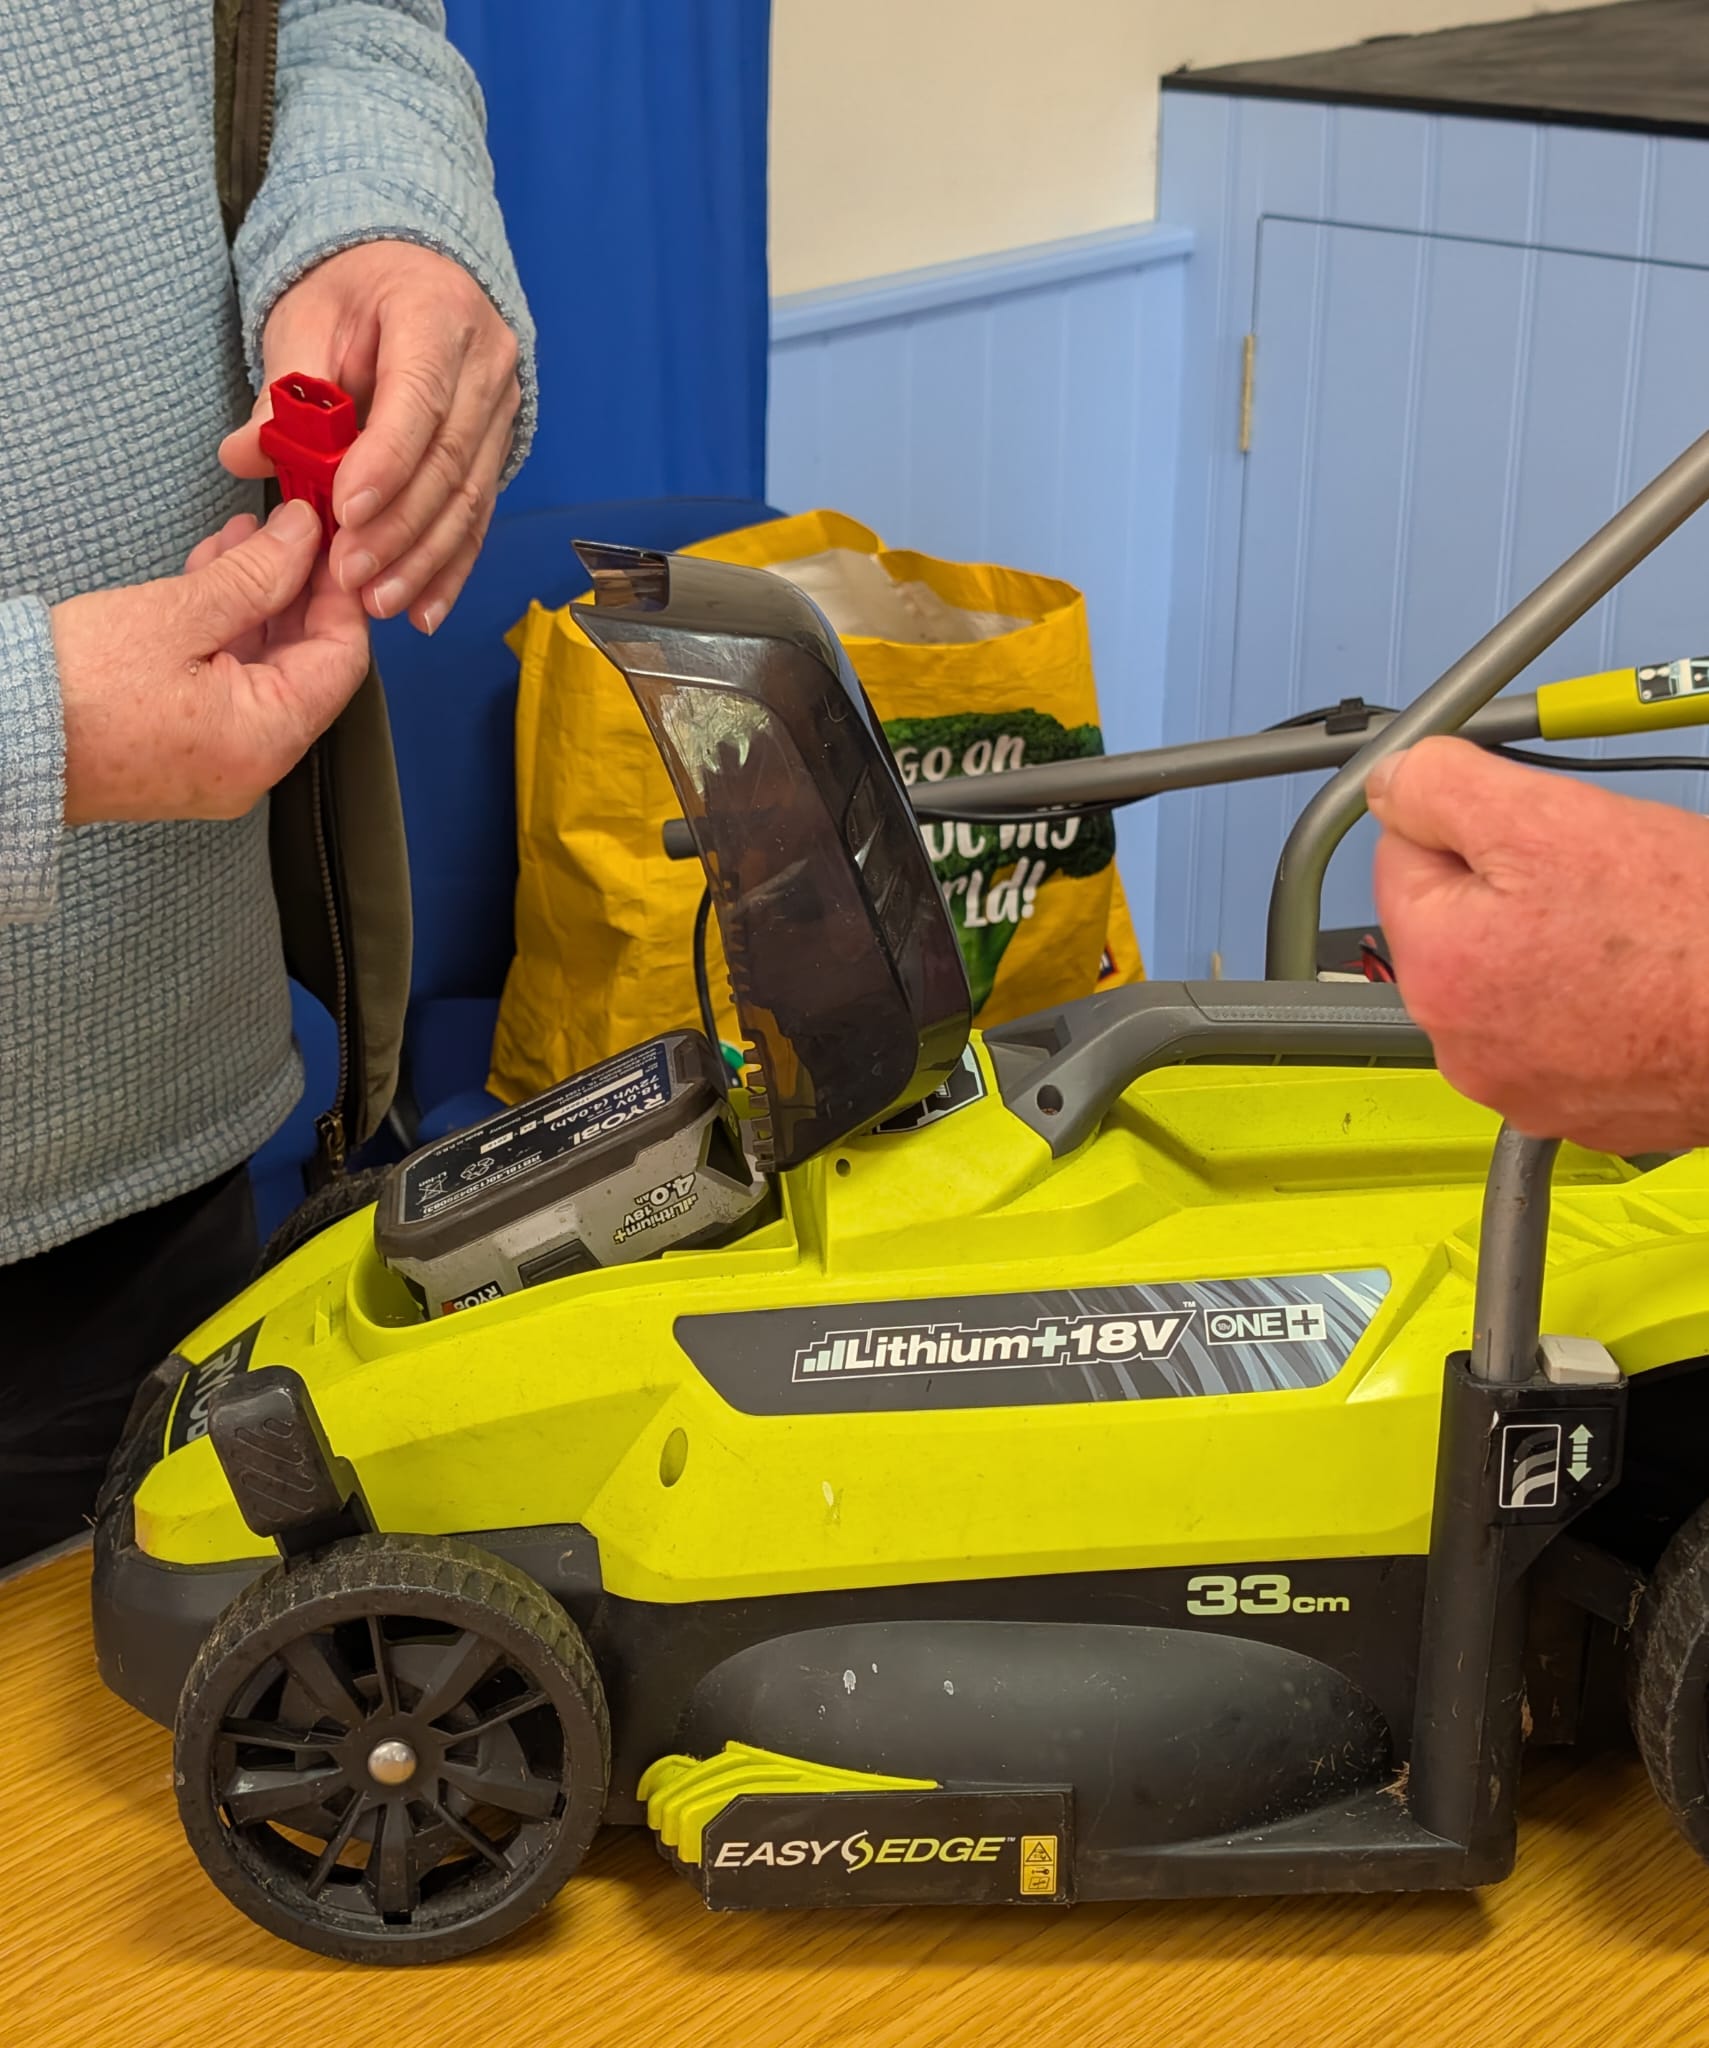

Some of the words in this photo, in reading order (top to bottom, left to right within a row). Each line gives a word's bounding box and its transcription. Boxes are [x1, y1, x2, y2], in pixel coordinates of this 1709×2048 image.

[942, 857, 1046, 928] rld!
[612, 1073, 659, 1102] 72Wh
[615, 1081, 659, 1108] 18.0V
[549, 1096, 608, 1132] (4.0Ah)
[571, 1090, 665, 1145] RYOBI
[624, 1206, 652, 1227] 18V
[1187, 1574, 1350, 1615] 33cm
[714, 1841, 841, 1868] EASY
[874, 1836, 1006, 1863] EDGE
